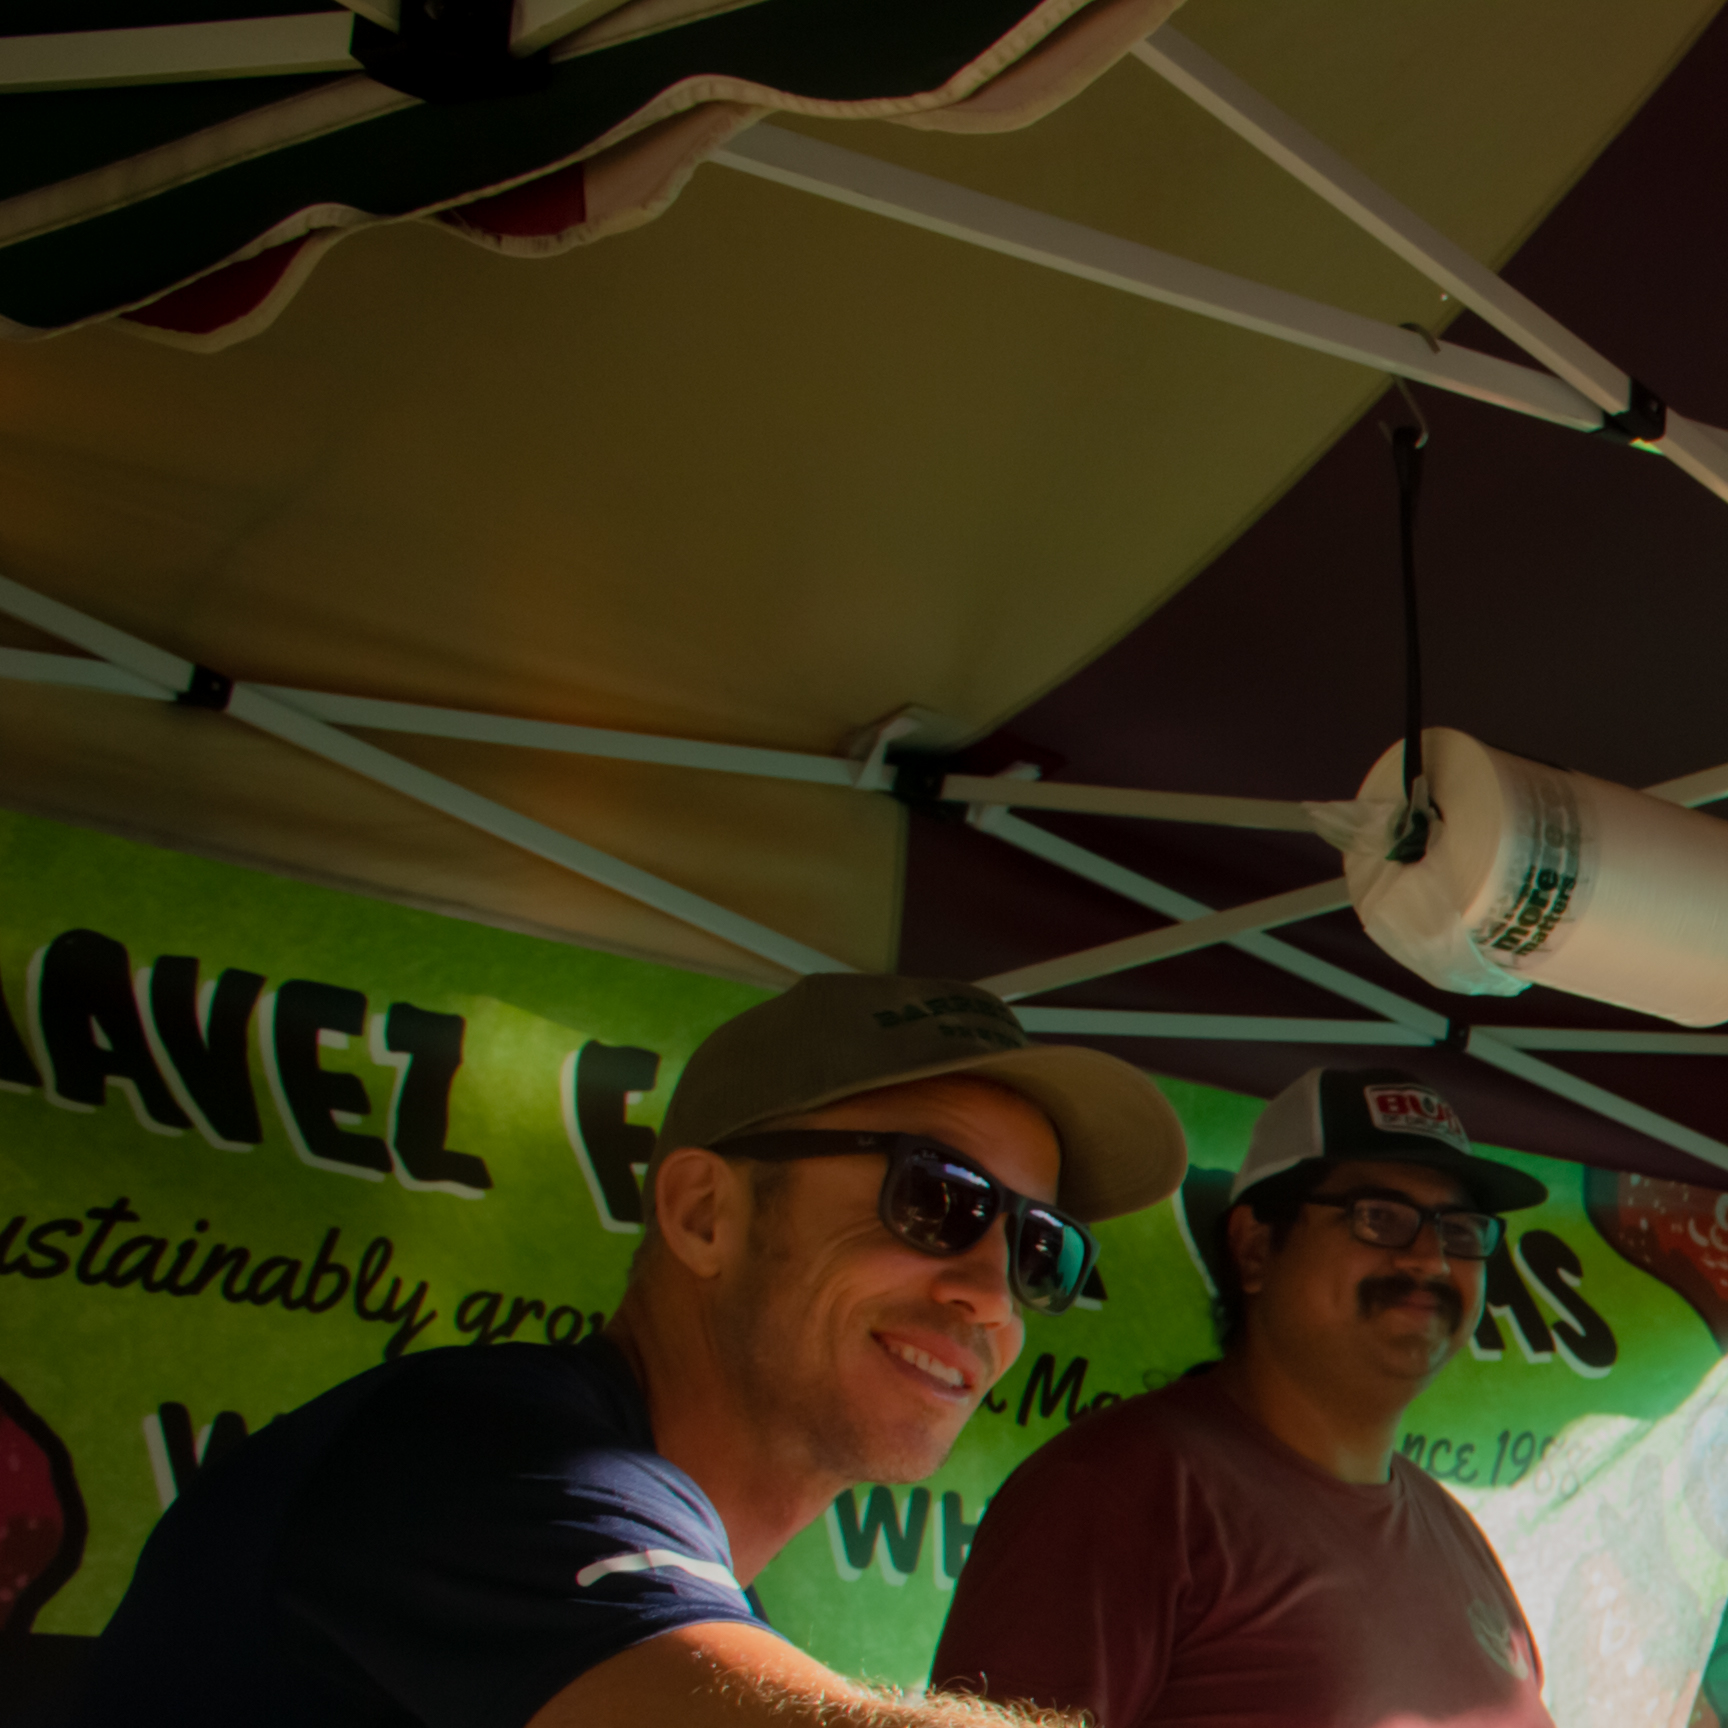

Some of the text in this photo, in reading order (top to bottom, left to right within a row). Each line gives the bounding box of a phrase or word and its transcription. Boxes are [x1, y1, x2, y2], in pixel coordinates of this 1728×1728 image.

[1489, 866, 1558, 952] more
[0, 928, 493, 1198] AVEZ
[455, 1290, 606, 1347] gro
